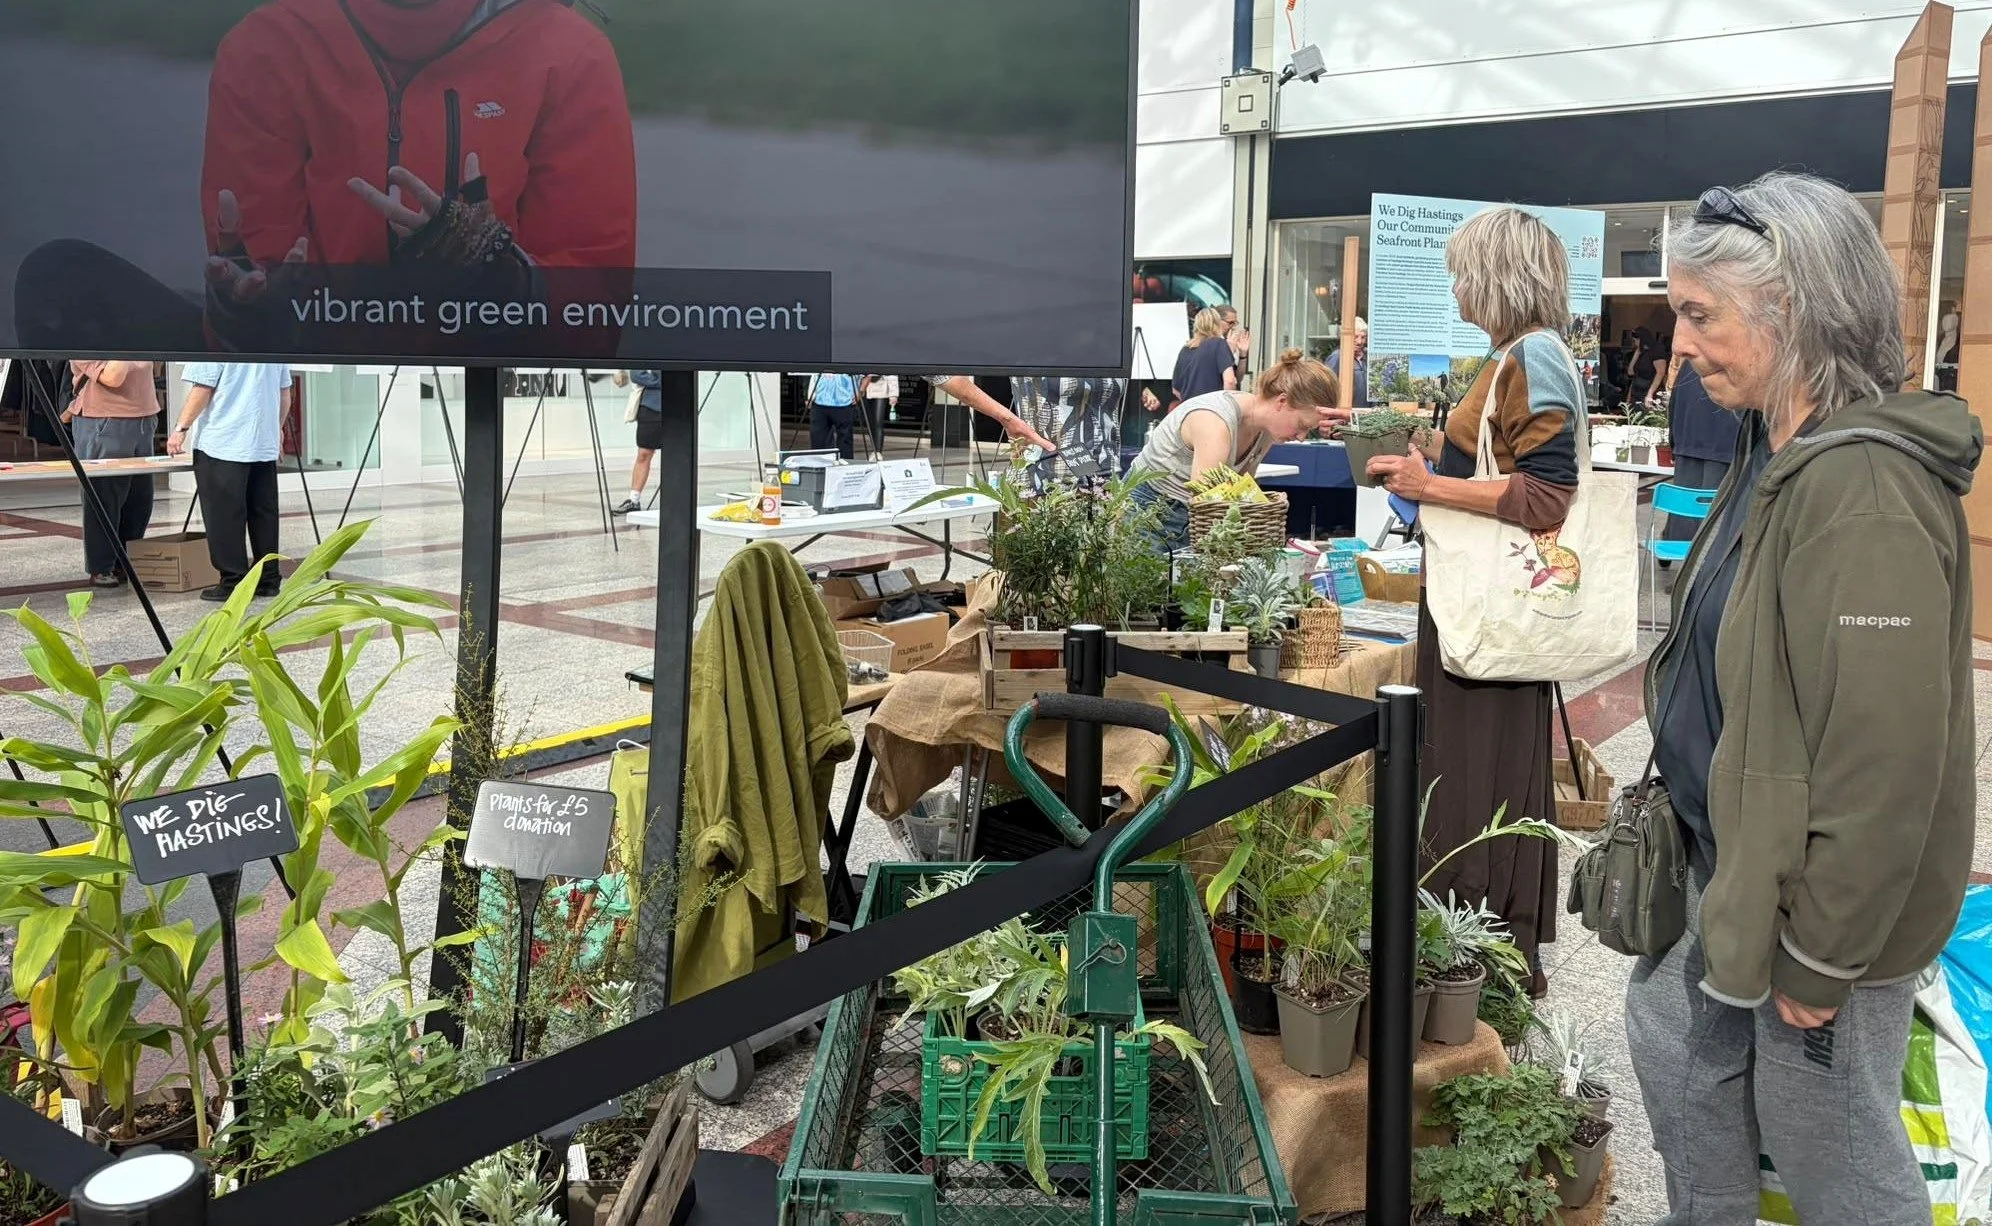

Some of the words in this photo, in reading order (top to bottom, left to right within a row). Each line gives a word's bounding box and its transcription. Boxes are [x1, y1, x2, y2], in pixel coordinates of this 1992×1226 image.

[1378, 204, 1395, 216] We
[1398, 206, 1415, 220] Dig
[1418, 207, 1464, 223] Hastings
[1377, 219, 1398, 231] Our
[1400, 221, 1456, 234] Communit
[1376, 234, 1422, 248] Seafront
[1424, 237, 1447, 249] Plan
[292, 288, 425, 323] vibrant
[438, 300, 547, 334] green
[563, 294, 808, 330] environment
[1839, 615, 1912, 629] macpac
[532, 793, 558, 815] for
[557, 794, 589, 817] £5
[132, 805, 181, 835] WE
[503, 811, 572, 836] donation
